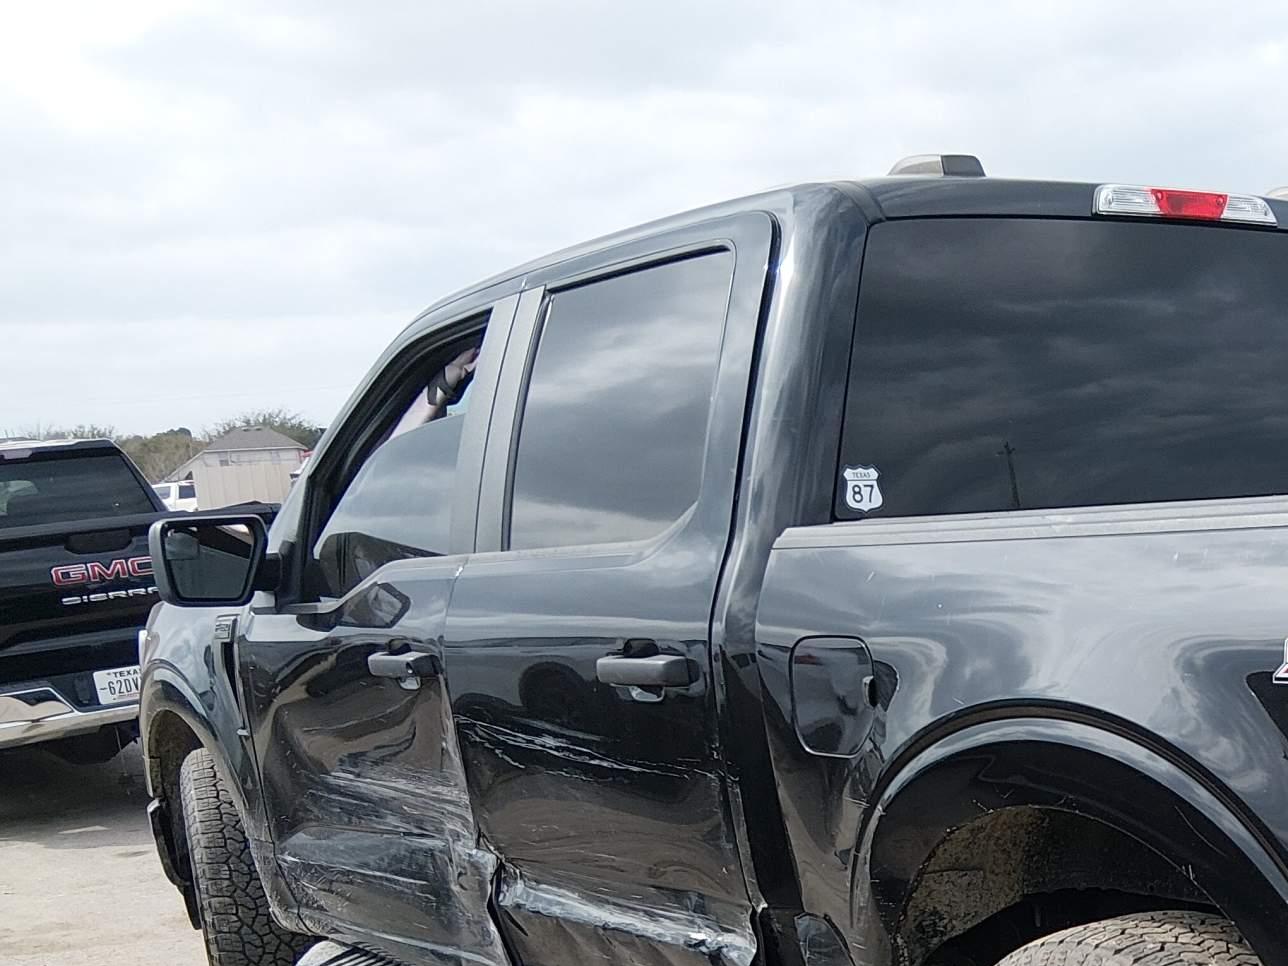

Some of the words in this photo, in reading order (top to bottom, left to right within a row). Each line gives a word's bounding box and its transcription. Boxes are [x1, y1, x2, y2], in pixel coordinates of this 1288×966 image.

[852, 471, 871, 479] TEXAS
[852, 484, 874, 503] 87
[51, 556, 155, 586] GMC
[113, 668, 141, 678] TEXA
